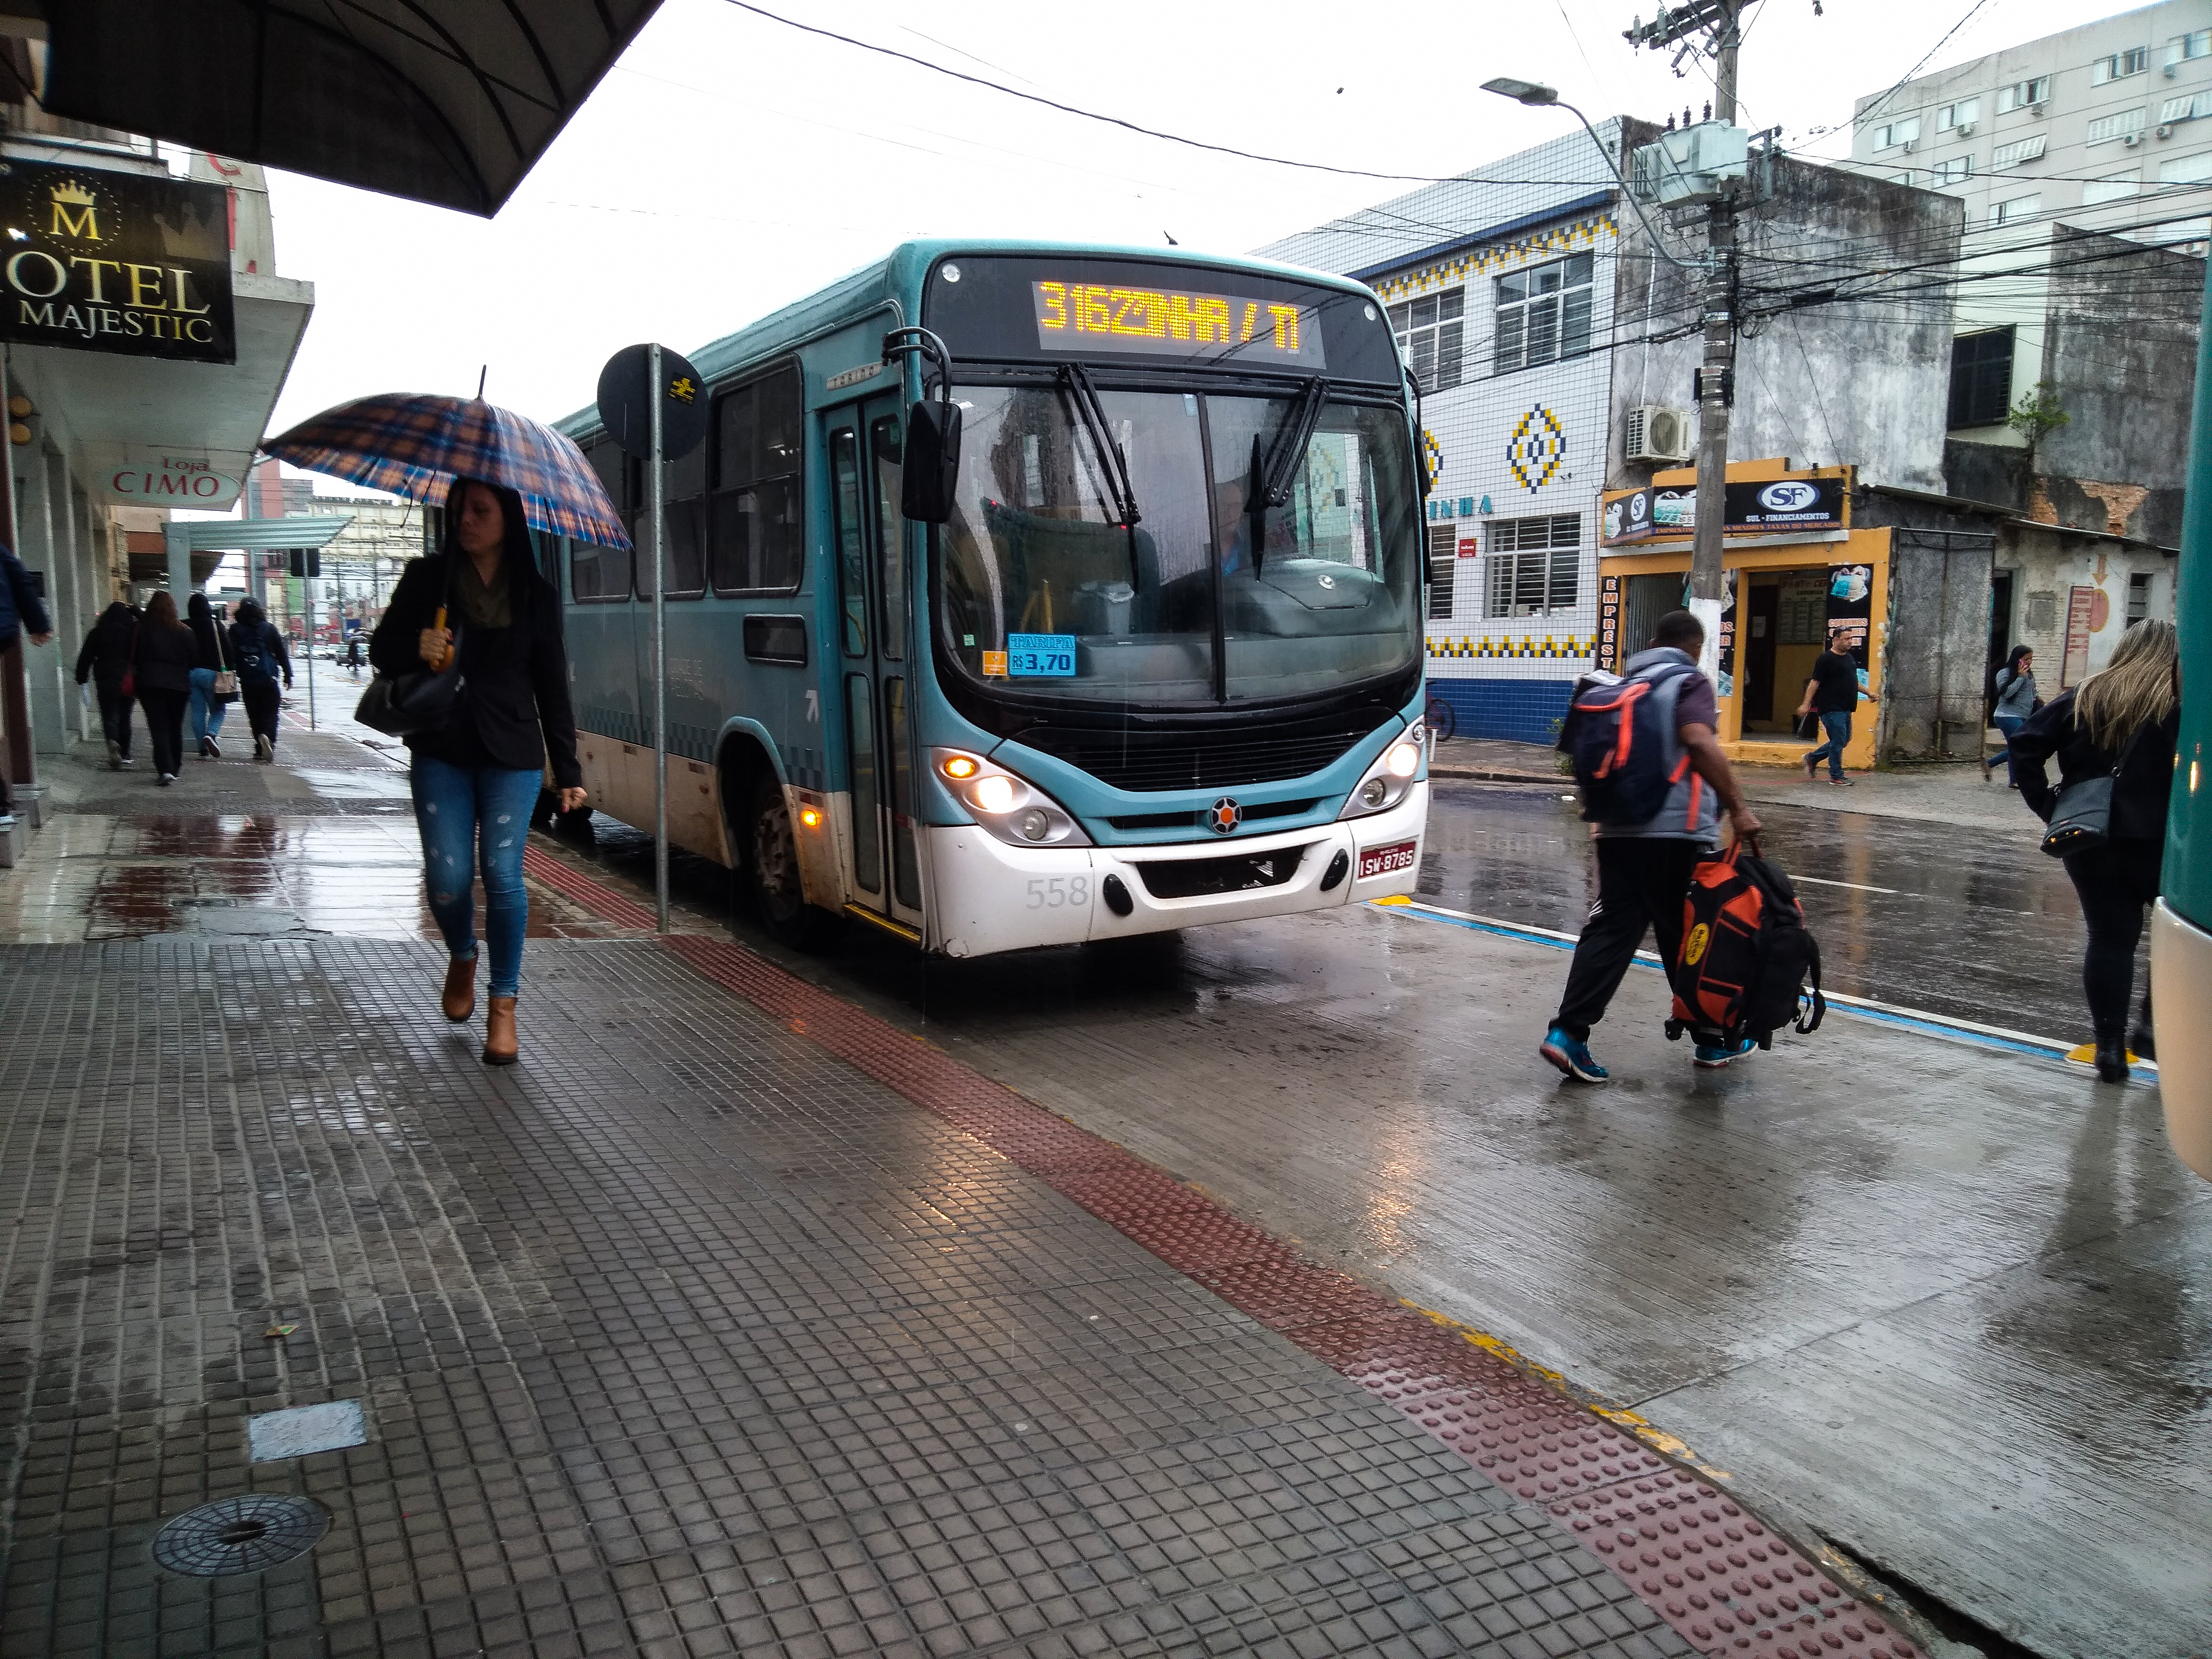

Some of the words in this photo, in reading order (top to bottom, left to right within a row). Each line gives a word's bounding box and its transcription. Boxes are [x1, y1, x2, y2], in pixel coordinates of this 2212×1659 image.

[49, 202, 103, 241] M
[0, 250, 211, 314] OTEL
[18, 299, 213, 343] MAJESTIC
[163, 458, 209, 475] Loja
[112, 471, 220, 498] CIMO
[1770, 487, 1807, 506] SF
[1428, 495, 1494, 520] INHA
[1766, 512, 1830, 521] FINANCIAMENTOS
[1011, 635, 1074, 648] TARIFA
[1026, 653, 1070, 673] 3,70
[1026, 876, 1088, 910] 558
